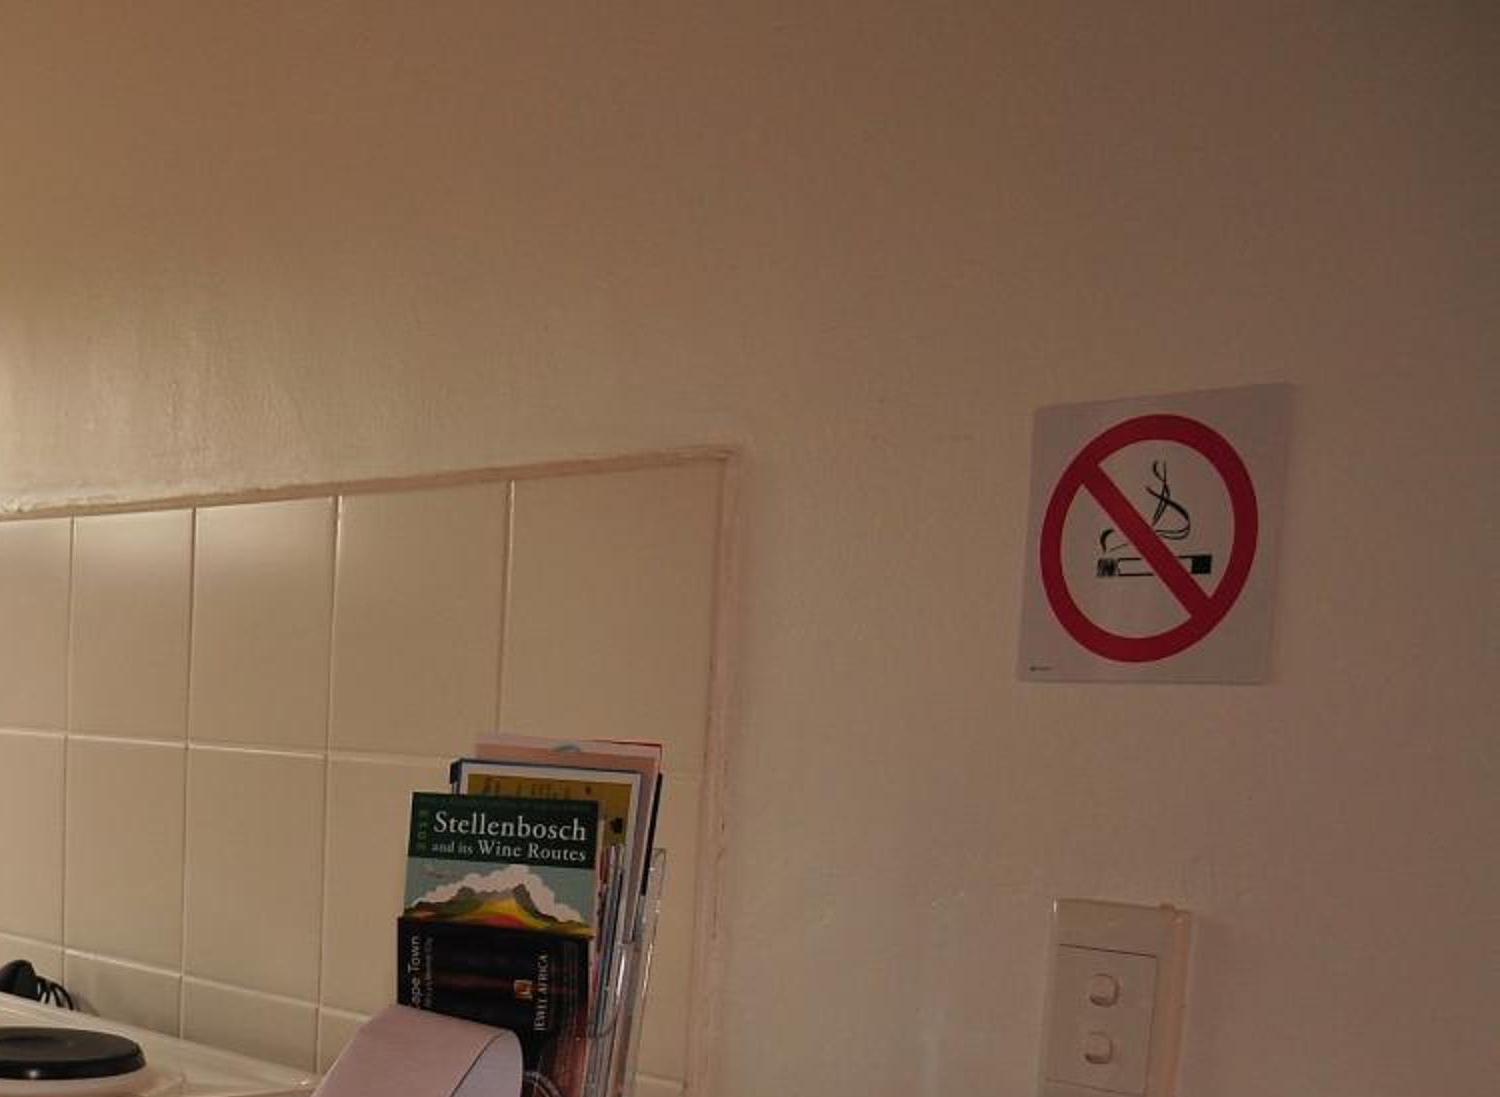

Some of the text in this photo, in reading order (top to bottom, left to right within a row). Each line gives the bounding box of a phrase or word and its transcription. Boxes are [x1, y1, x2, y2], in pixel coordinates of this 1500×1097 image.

[432, 810, 586, 842] Stellenbosch
[431, 839, 586, 863] and its Wine Routes
[407, 935, 421, 1006] ape Town
[537, 953, 549, 994] AFRICA
